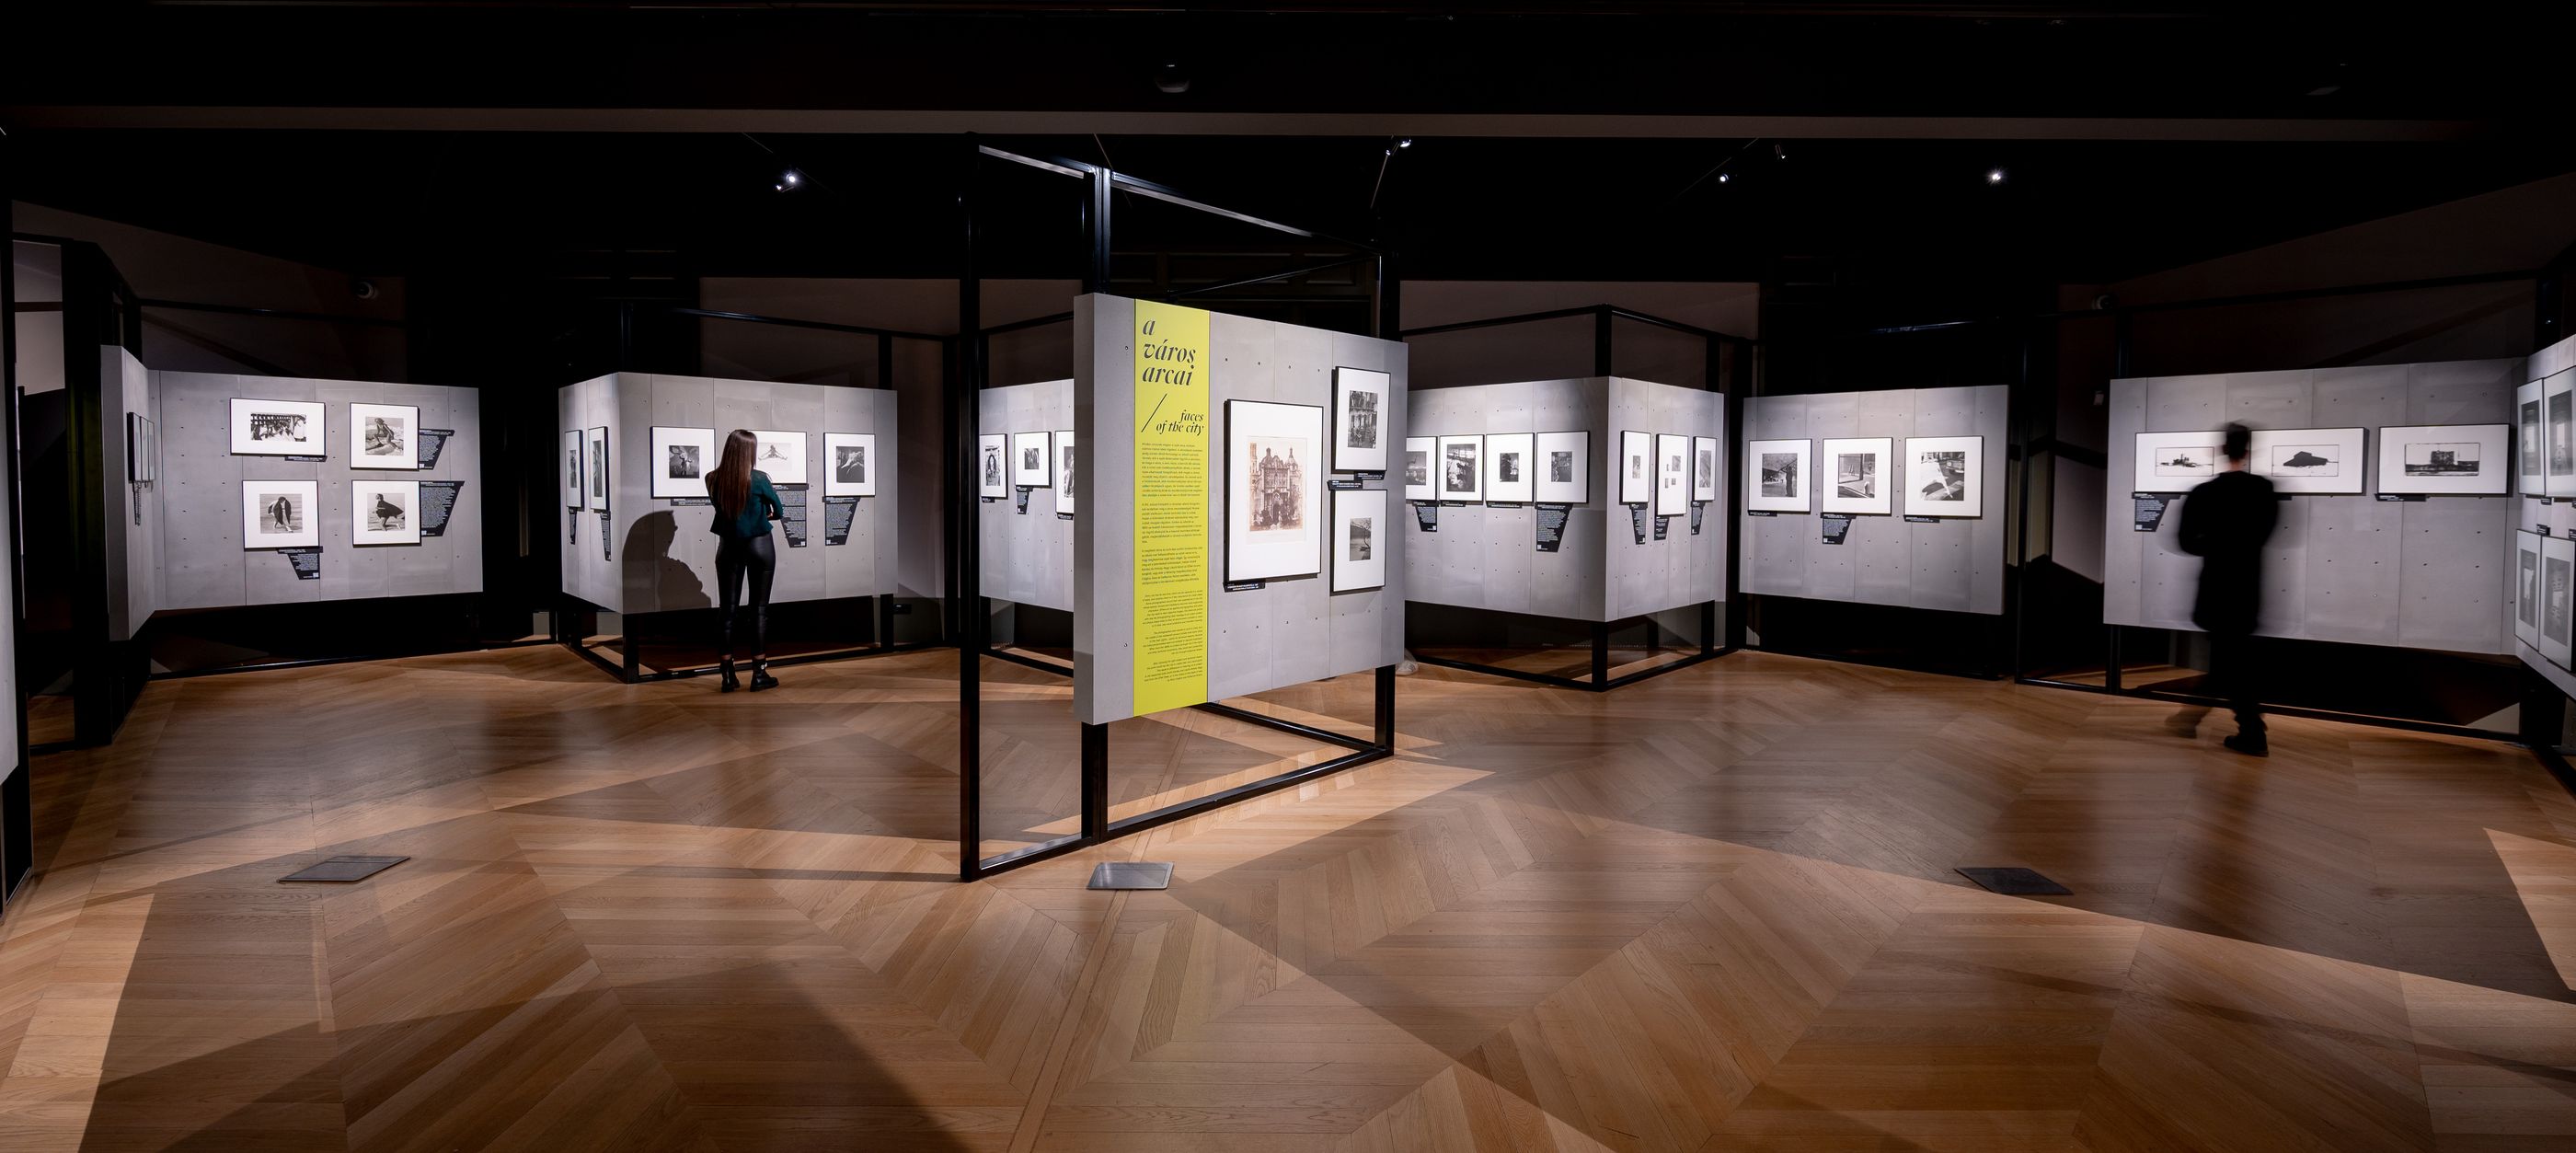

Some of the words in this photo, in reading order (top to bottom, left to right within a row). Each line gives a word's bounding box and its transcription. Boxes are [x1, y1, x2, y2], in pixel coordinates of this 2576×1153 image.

[1142, 319, 1156, 336] a
[1144, 339, 1196, 363] város
[1142, 364, 1194, 386] arcai
[1179, 409, 1204, 423] faces
[1156, 420, 1168, 435] of
[1168, 421, 1184, 432] the
[1186, 422, 1204, 436] city
